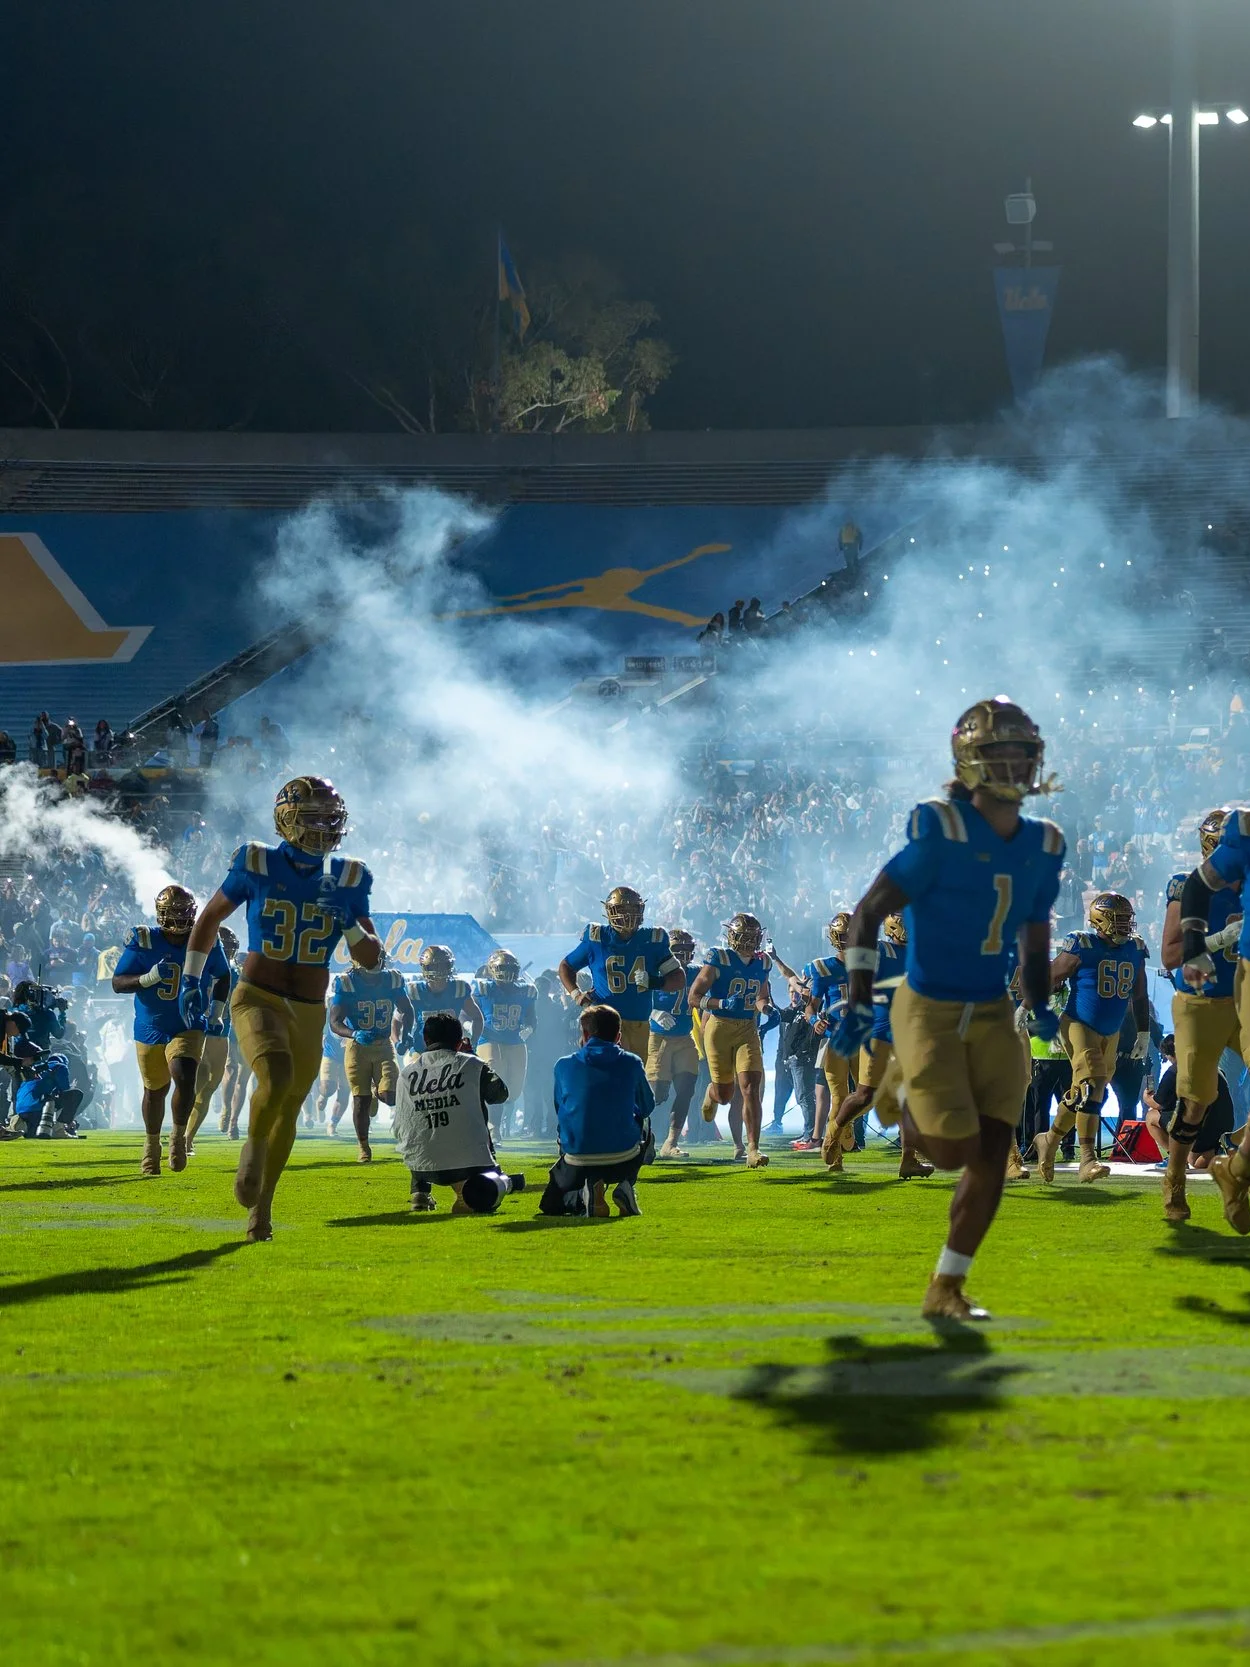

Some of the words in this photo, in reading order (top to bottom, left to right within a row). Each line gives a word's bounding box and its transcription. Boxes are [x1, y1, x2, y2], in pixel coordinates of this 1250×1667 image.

[262, 899, 335, 964] 32
[980, 873, 1013, 956] 1
[156, 961, 183, 1001] 9
[605, 955, 648, 994] 64
[1097, 959, 1135, 999] 68
[357, 1000, 394, 1030] 33
[408, 1064, 465, 1096] Ucla
[414, 1095, 460, 1111] MEDIA
[425, 1111, 449, 1129] 179
